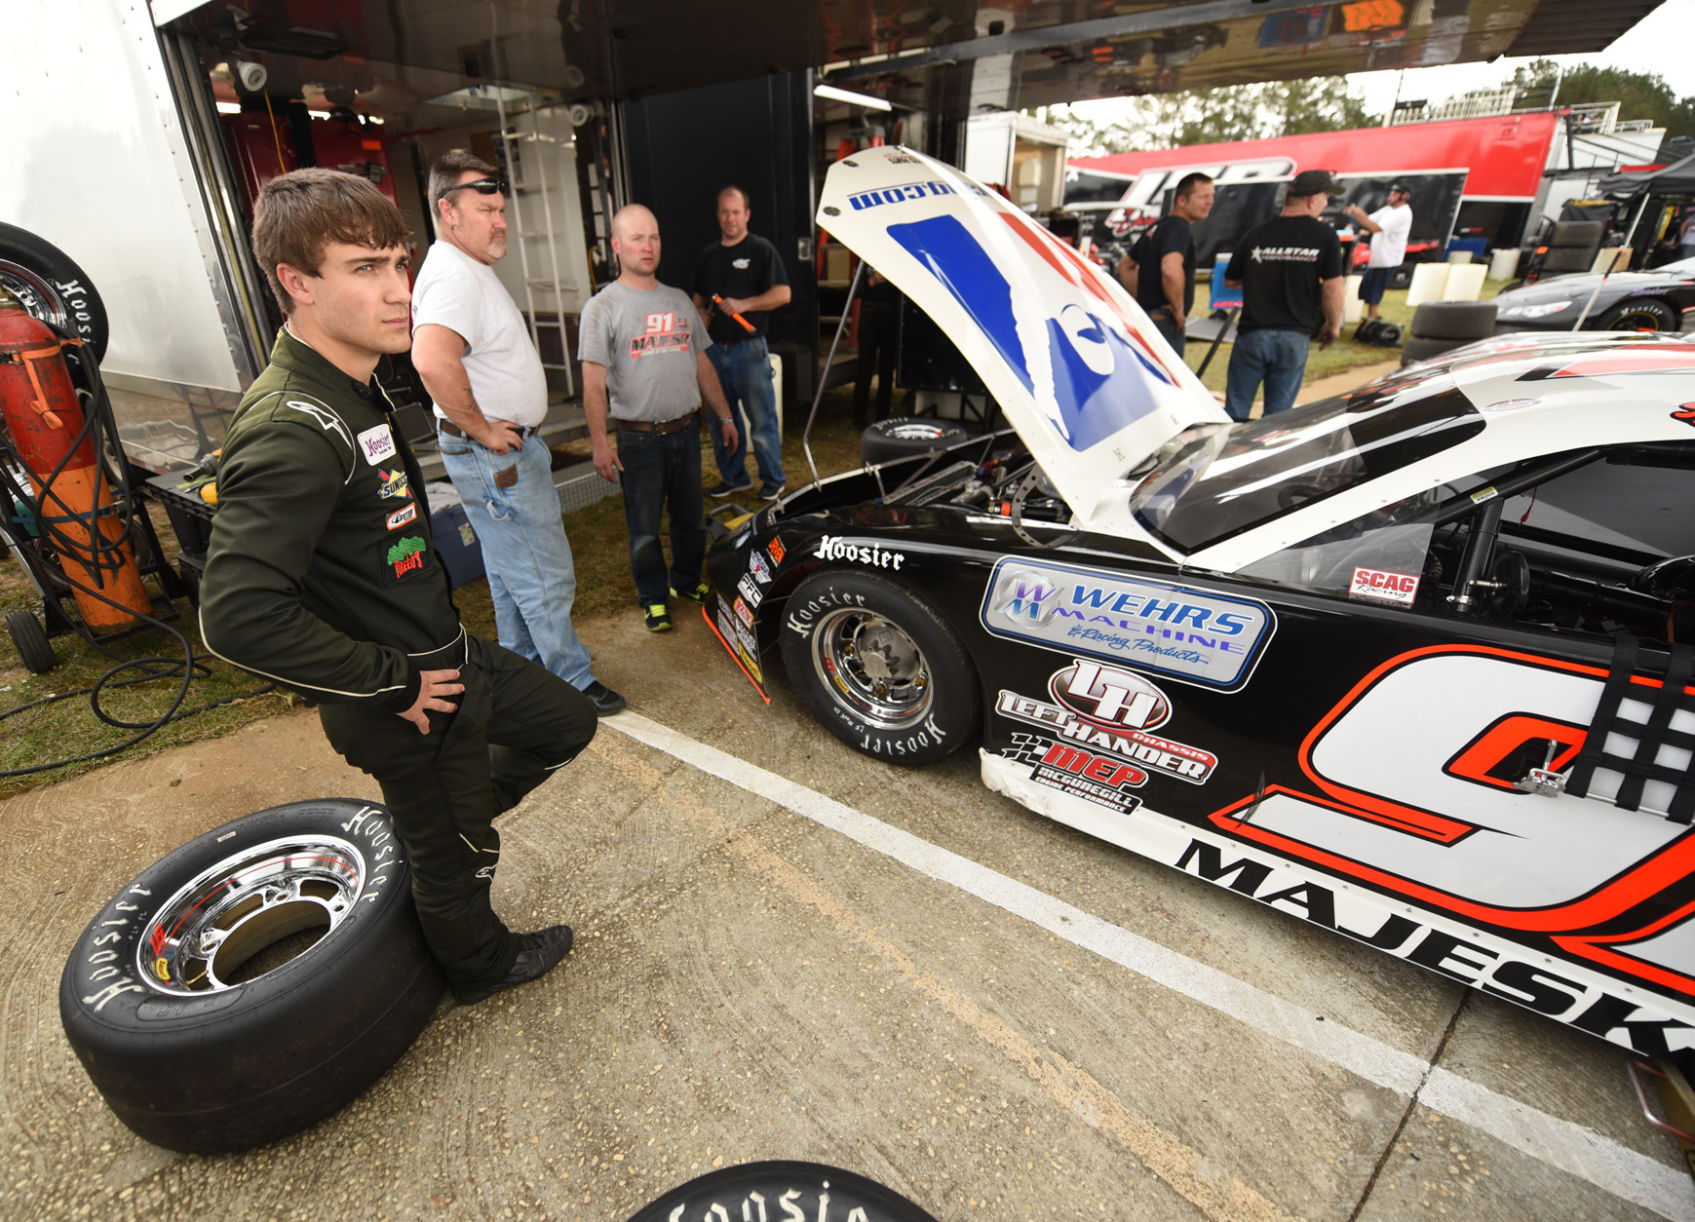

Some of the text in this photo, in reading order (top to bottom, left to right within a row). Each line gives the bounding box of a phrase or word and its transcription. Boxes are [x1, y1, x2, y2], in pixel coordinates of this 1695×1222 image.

[1261, 247, 1320, 258] ALLSTAR
[645, 312, 675, 333] 91
[812, 535, 905, 571] Hoosier
[1355, 570, 1416, 593] SCAG
[787, 586, 865, 638] Hoosier
[1072, 584, 1253, 636] WEHRS
[1051, 607, 1245, 655] MACHINE
[1080, 628, 1131, 650] Racing
[1133, 638, 1209, 665] Products
[1000, 693, 1072, 726] LEFT
[860, 713, 947, 759] Hoosier
[1063, 720, 1209, 780] HANDER
[1132, 732, 1209, 761] CHASSIS
[1041, 743, 1147, 787] MEP
[1035, 776, 1127, 813] ENGINE PERFORMANCE
[341, 806, 404, 902] Hoosier
[82, 884, 152, 1012] Hoosier
